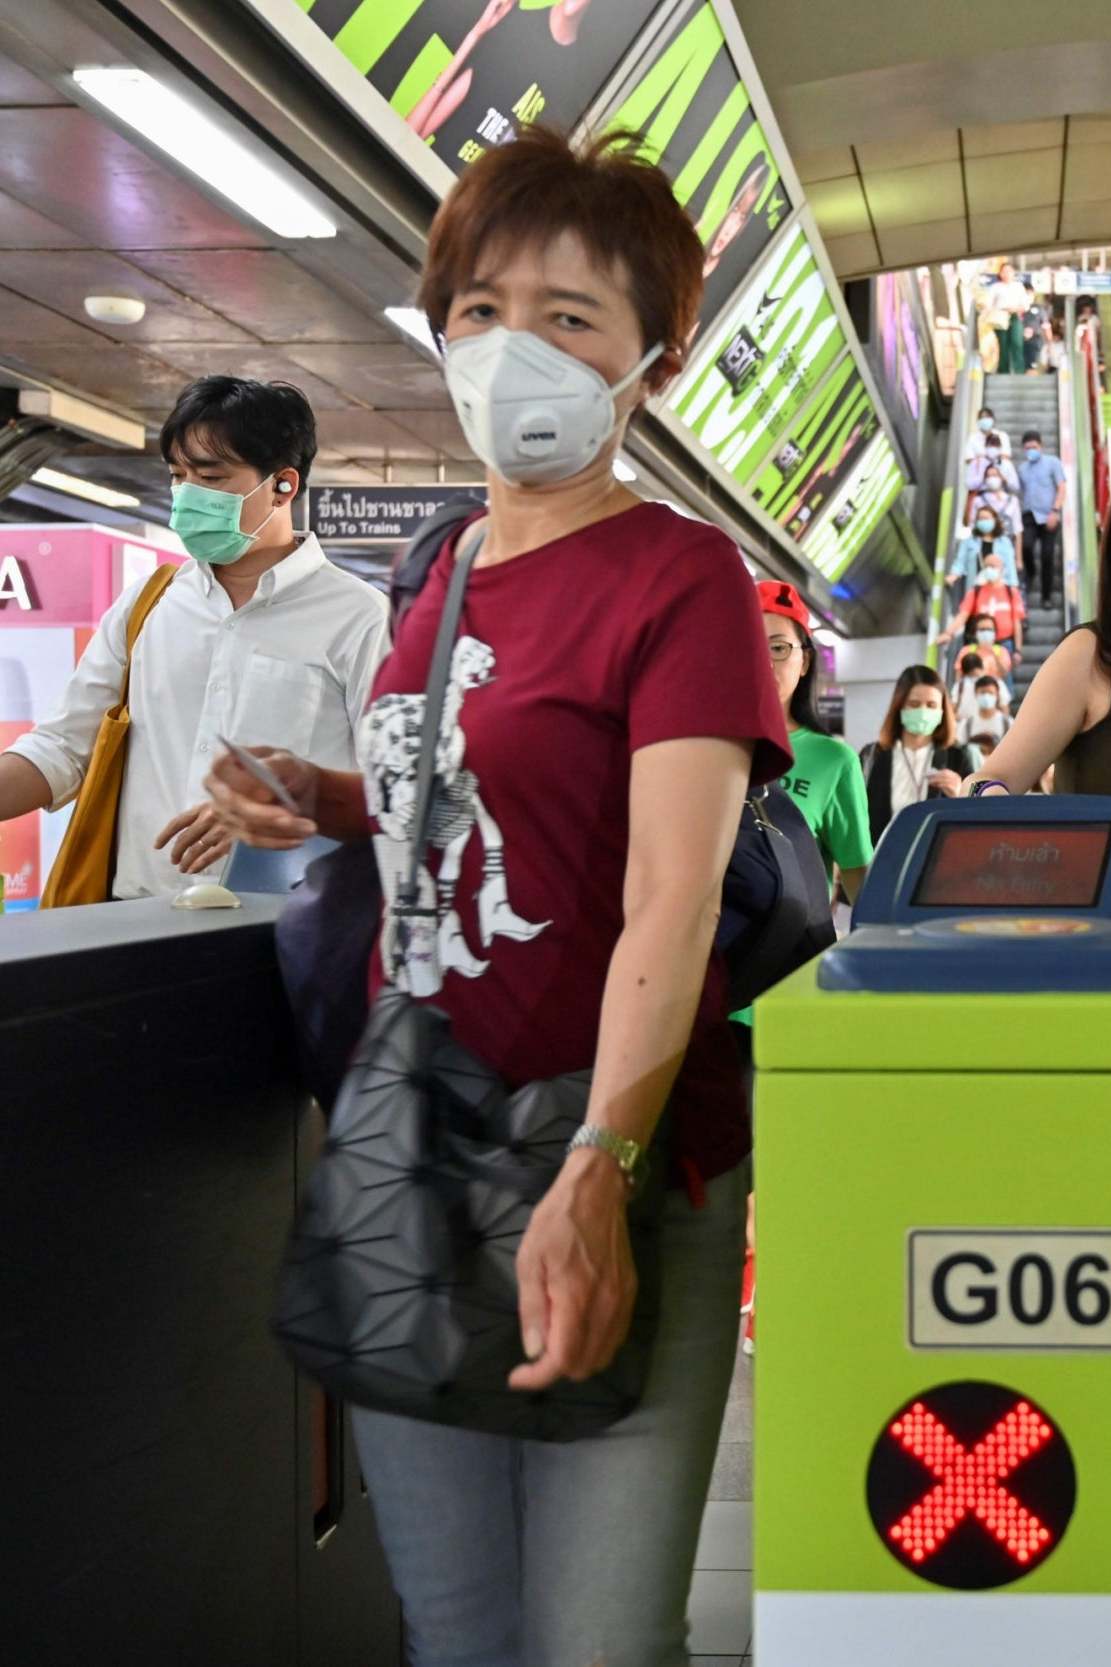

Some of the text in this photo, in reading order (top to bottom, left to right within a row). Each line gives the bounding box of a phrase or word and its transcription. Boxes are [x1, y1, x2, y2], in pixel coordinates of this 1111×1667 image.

[521, 431, 557, 442] uvex
[318, 521, 401, 536] Up To Trains
